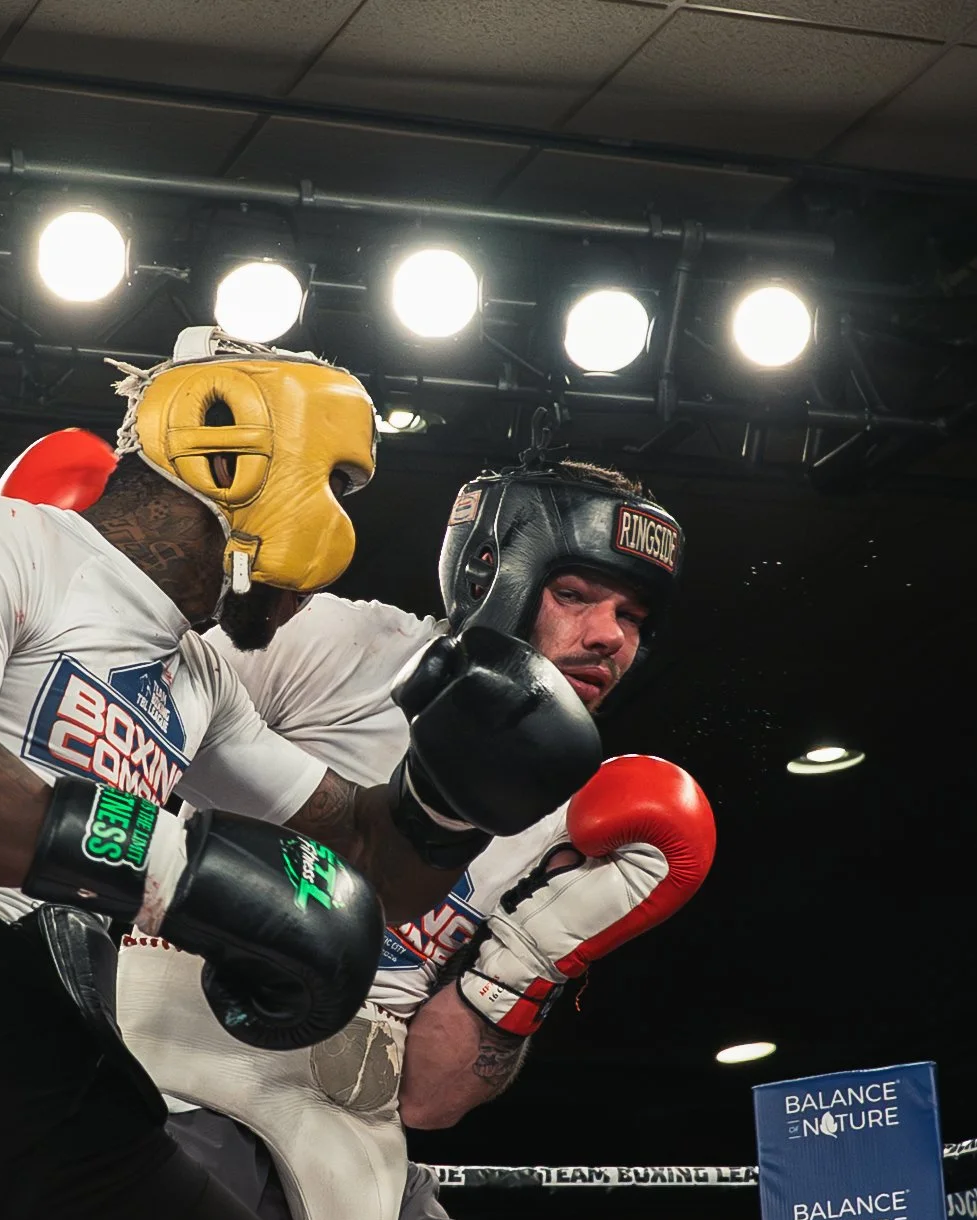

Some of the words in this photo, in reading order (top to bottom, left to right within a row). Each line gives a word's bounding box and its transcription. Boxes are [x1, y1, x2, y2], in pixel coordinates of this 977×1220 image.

[57, 674, 182, 807] BOXIN
[785, 1081, 897, 1114] BALANCE
[542, 1167, 610, 1184] TEAM
[617, 1167, 709, 1183] BOXING
[716, 1167, 758, 1183] LEA
